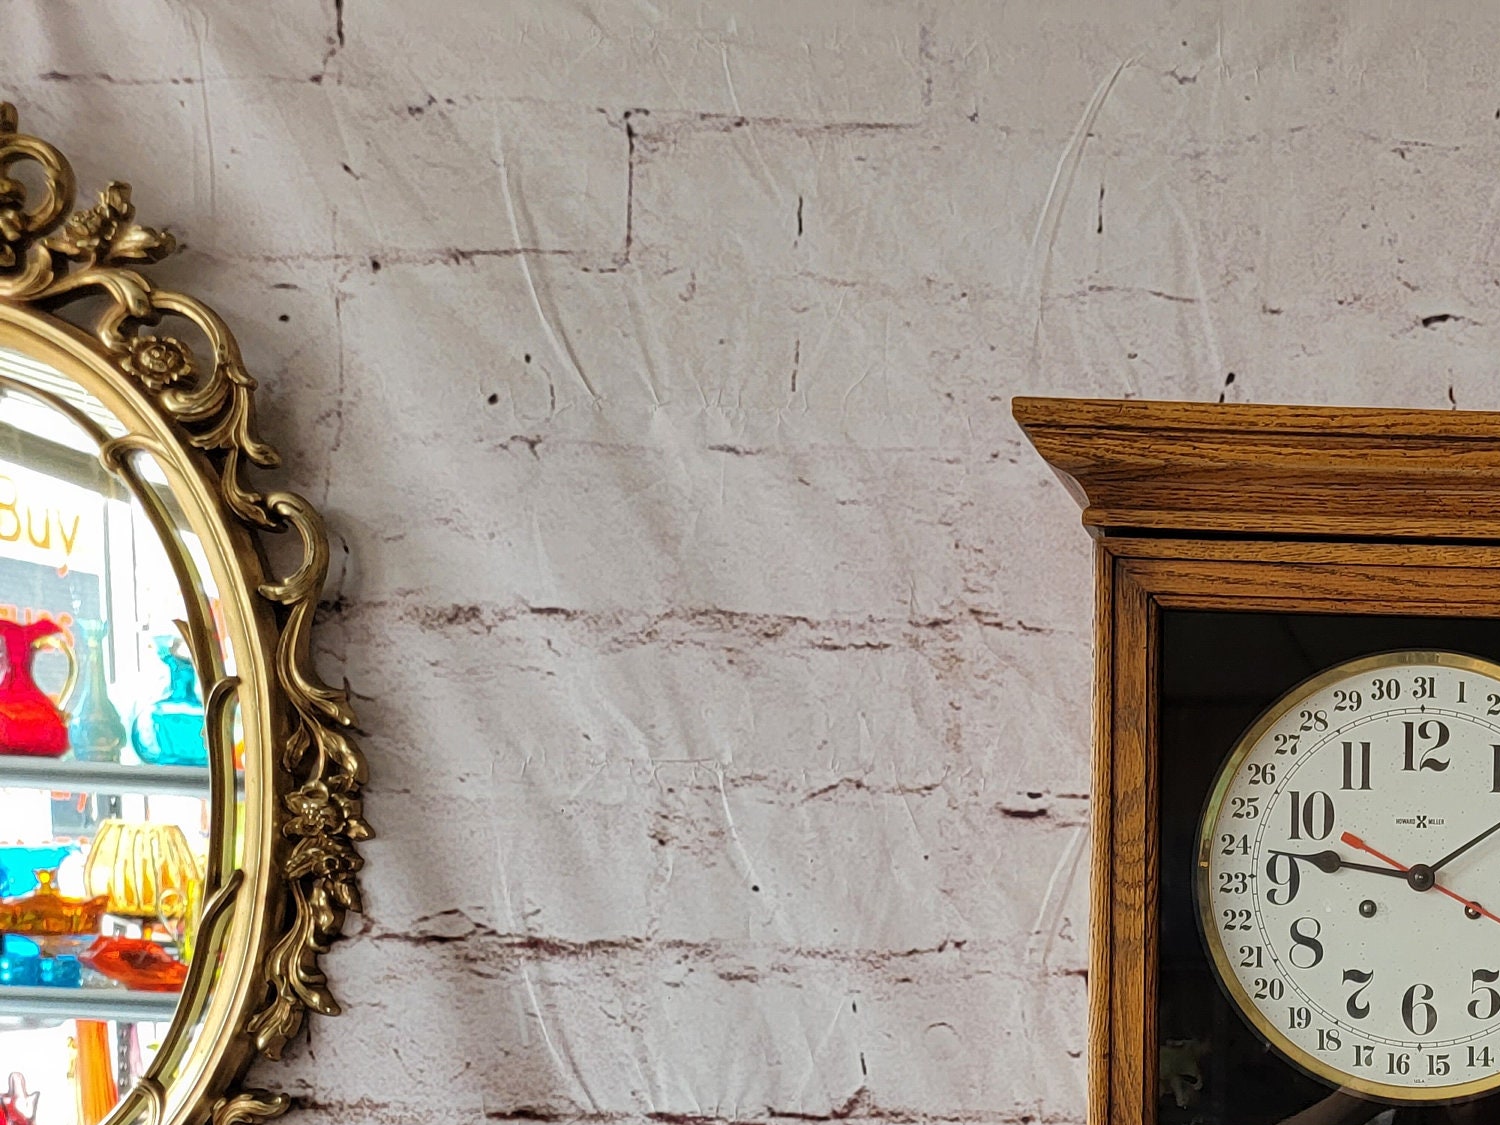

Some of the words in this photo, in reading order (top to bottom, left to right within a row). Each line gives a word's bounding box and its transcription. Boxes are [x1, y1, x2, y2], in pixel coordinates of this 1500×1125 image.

[1370, 678, 1401, 701] 30
[1412, 676, 1436, 699] 31
[1456, 681, 1467, 704] 1
[1333, 689, 1362, 712] 29
[1299, 709, 1329, 732] 28
[1273, 733, 1302, 756] 27
[1402, 719, 1451, 772] 12
[1247, 762, 1276, 786] 26
[1340, 741, 1372, 791] 11
[1230, 796, 1260, 820] 25
[1287, 790, 1335, 841] 10
[1220, 833, 1252, 856] 24
[1218, 871, 1250, 895] 23
[1265, 851, 1303, 906] 9
[1221, 908, 1253, 932] 22
[1288, 916, 1324, 969] 8
[1239, 945, 1264, 969] 21
[1253, 976, 1286, 1001] 20
[1341, 968, 1374, 1020] 7
[1287, 1005, 1314, 1030] 19
[1401, 983, 1438, 1036] 6
[1316, 1026, 1343, 1052] 18
[1352, 1044, 1375, 1067] 17
[1386, 1052, 1410, 1075] 16
[1426, 1054, 1451, 1076] 15
[1466, 1045, 1495, 1067] 14
